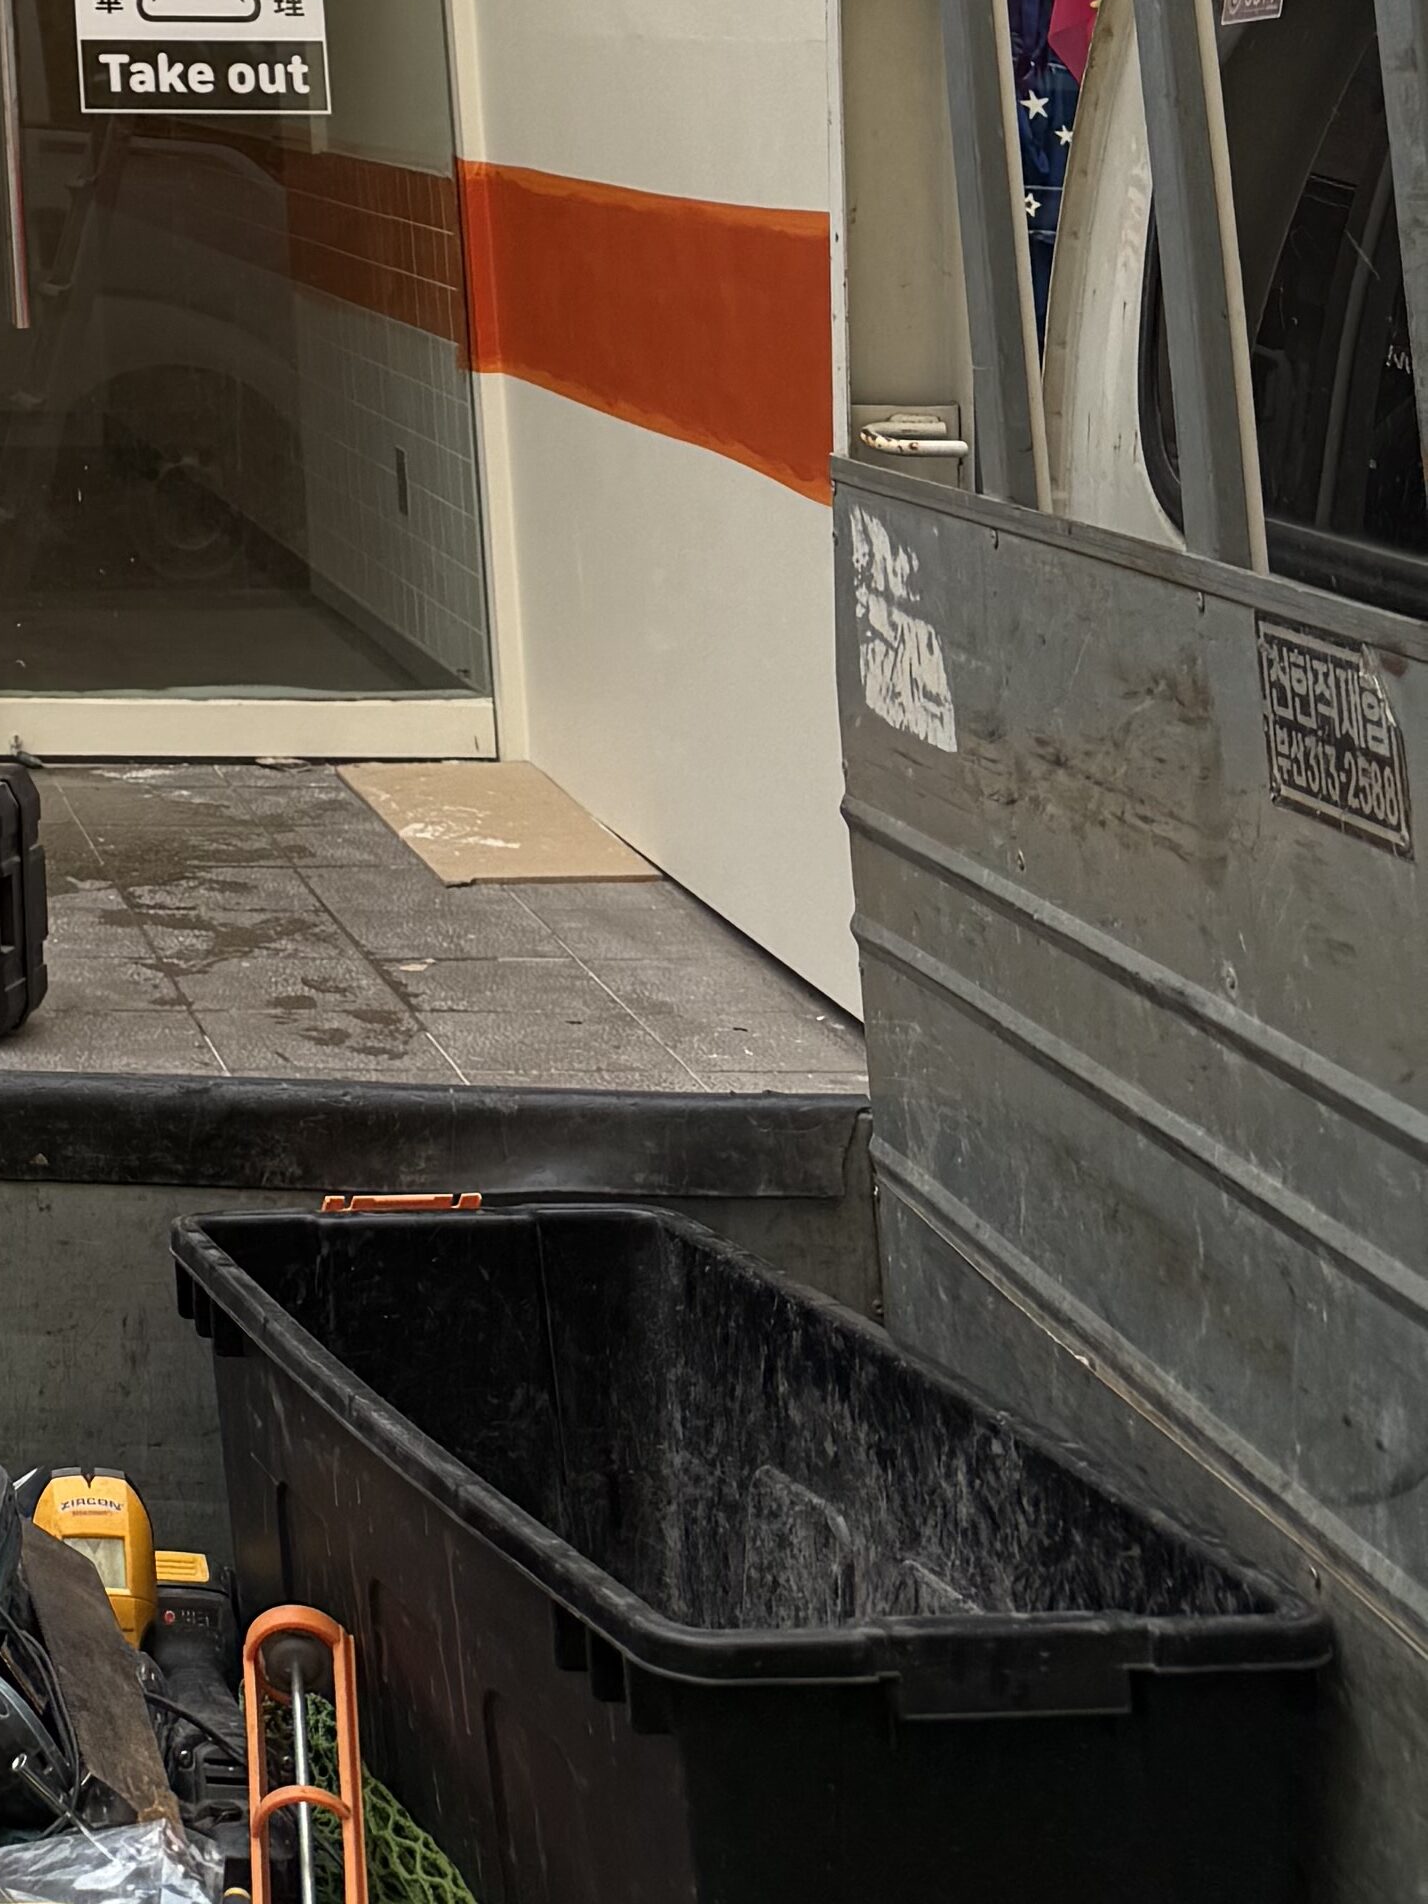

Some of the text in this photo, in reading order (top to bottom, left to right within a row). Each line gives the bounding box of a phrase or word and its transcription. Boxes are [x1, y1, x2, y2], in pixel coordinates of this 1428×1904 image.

[98, 53, 310, 95] Take out
[61, 1497, 123, 1511] ZIRCON
